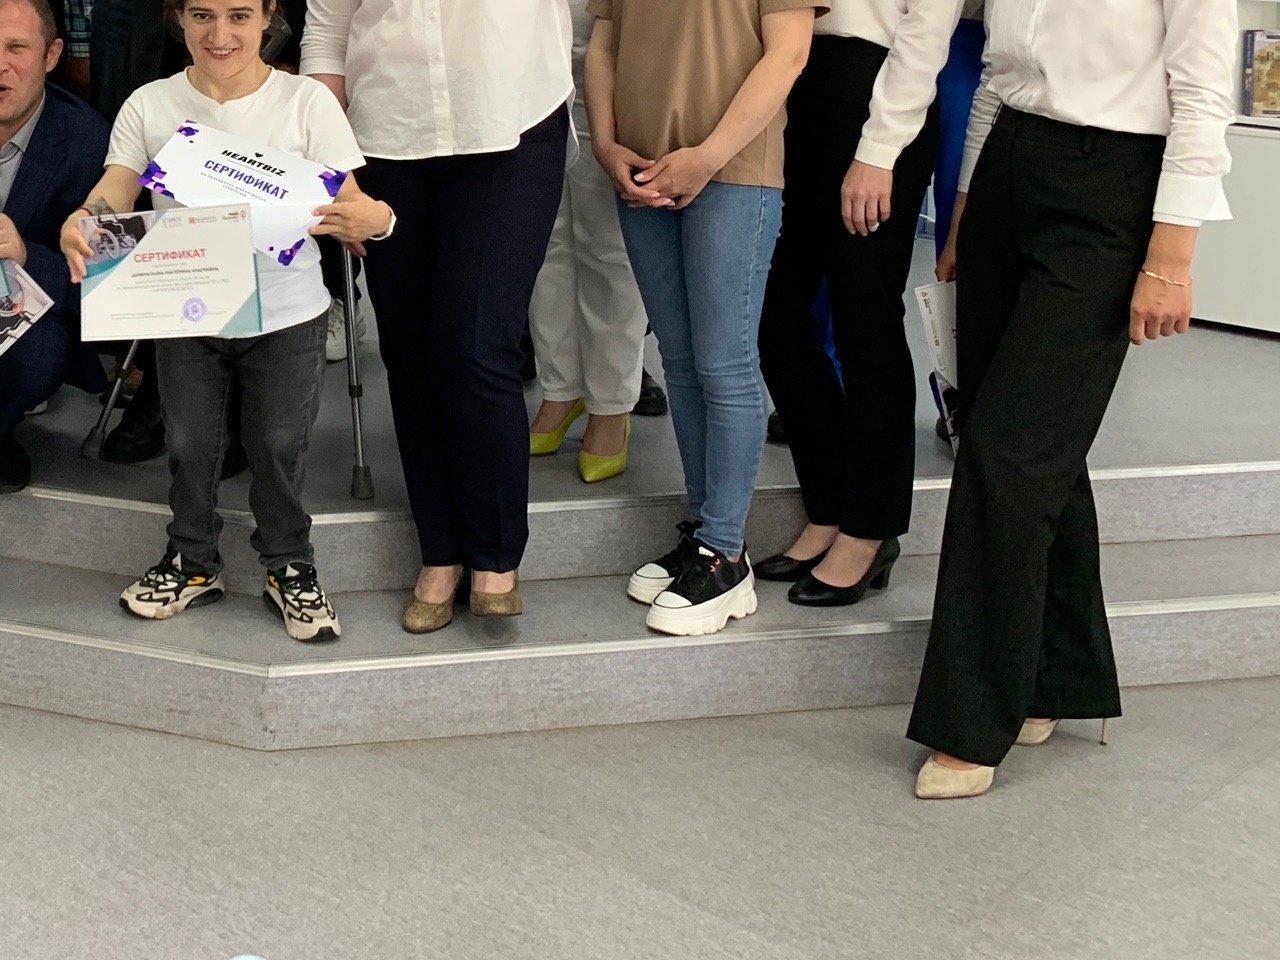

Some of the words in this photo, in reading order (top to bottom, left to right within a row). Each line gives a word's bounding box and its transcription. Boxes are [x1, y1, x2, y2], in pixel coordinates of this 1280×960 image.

[221, 149, 286, 176] HEARTBIZ
[203, 159, 289, 201] СЕРТИФИКАТ
[134, 248, 207, 263] СЕРТИФИКАТ
